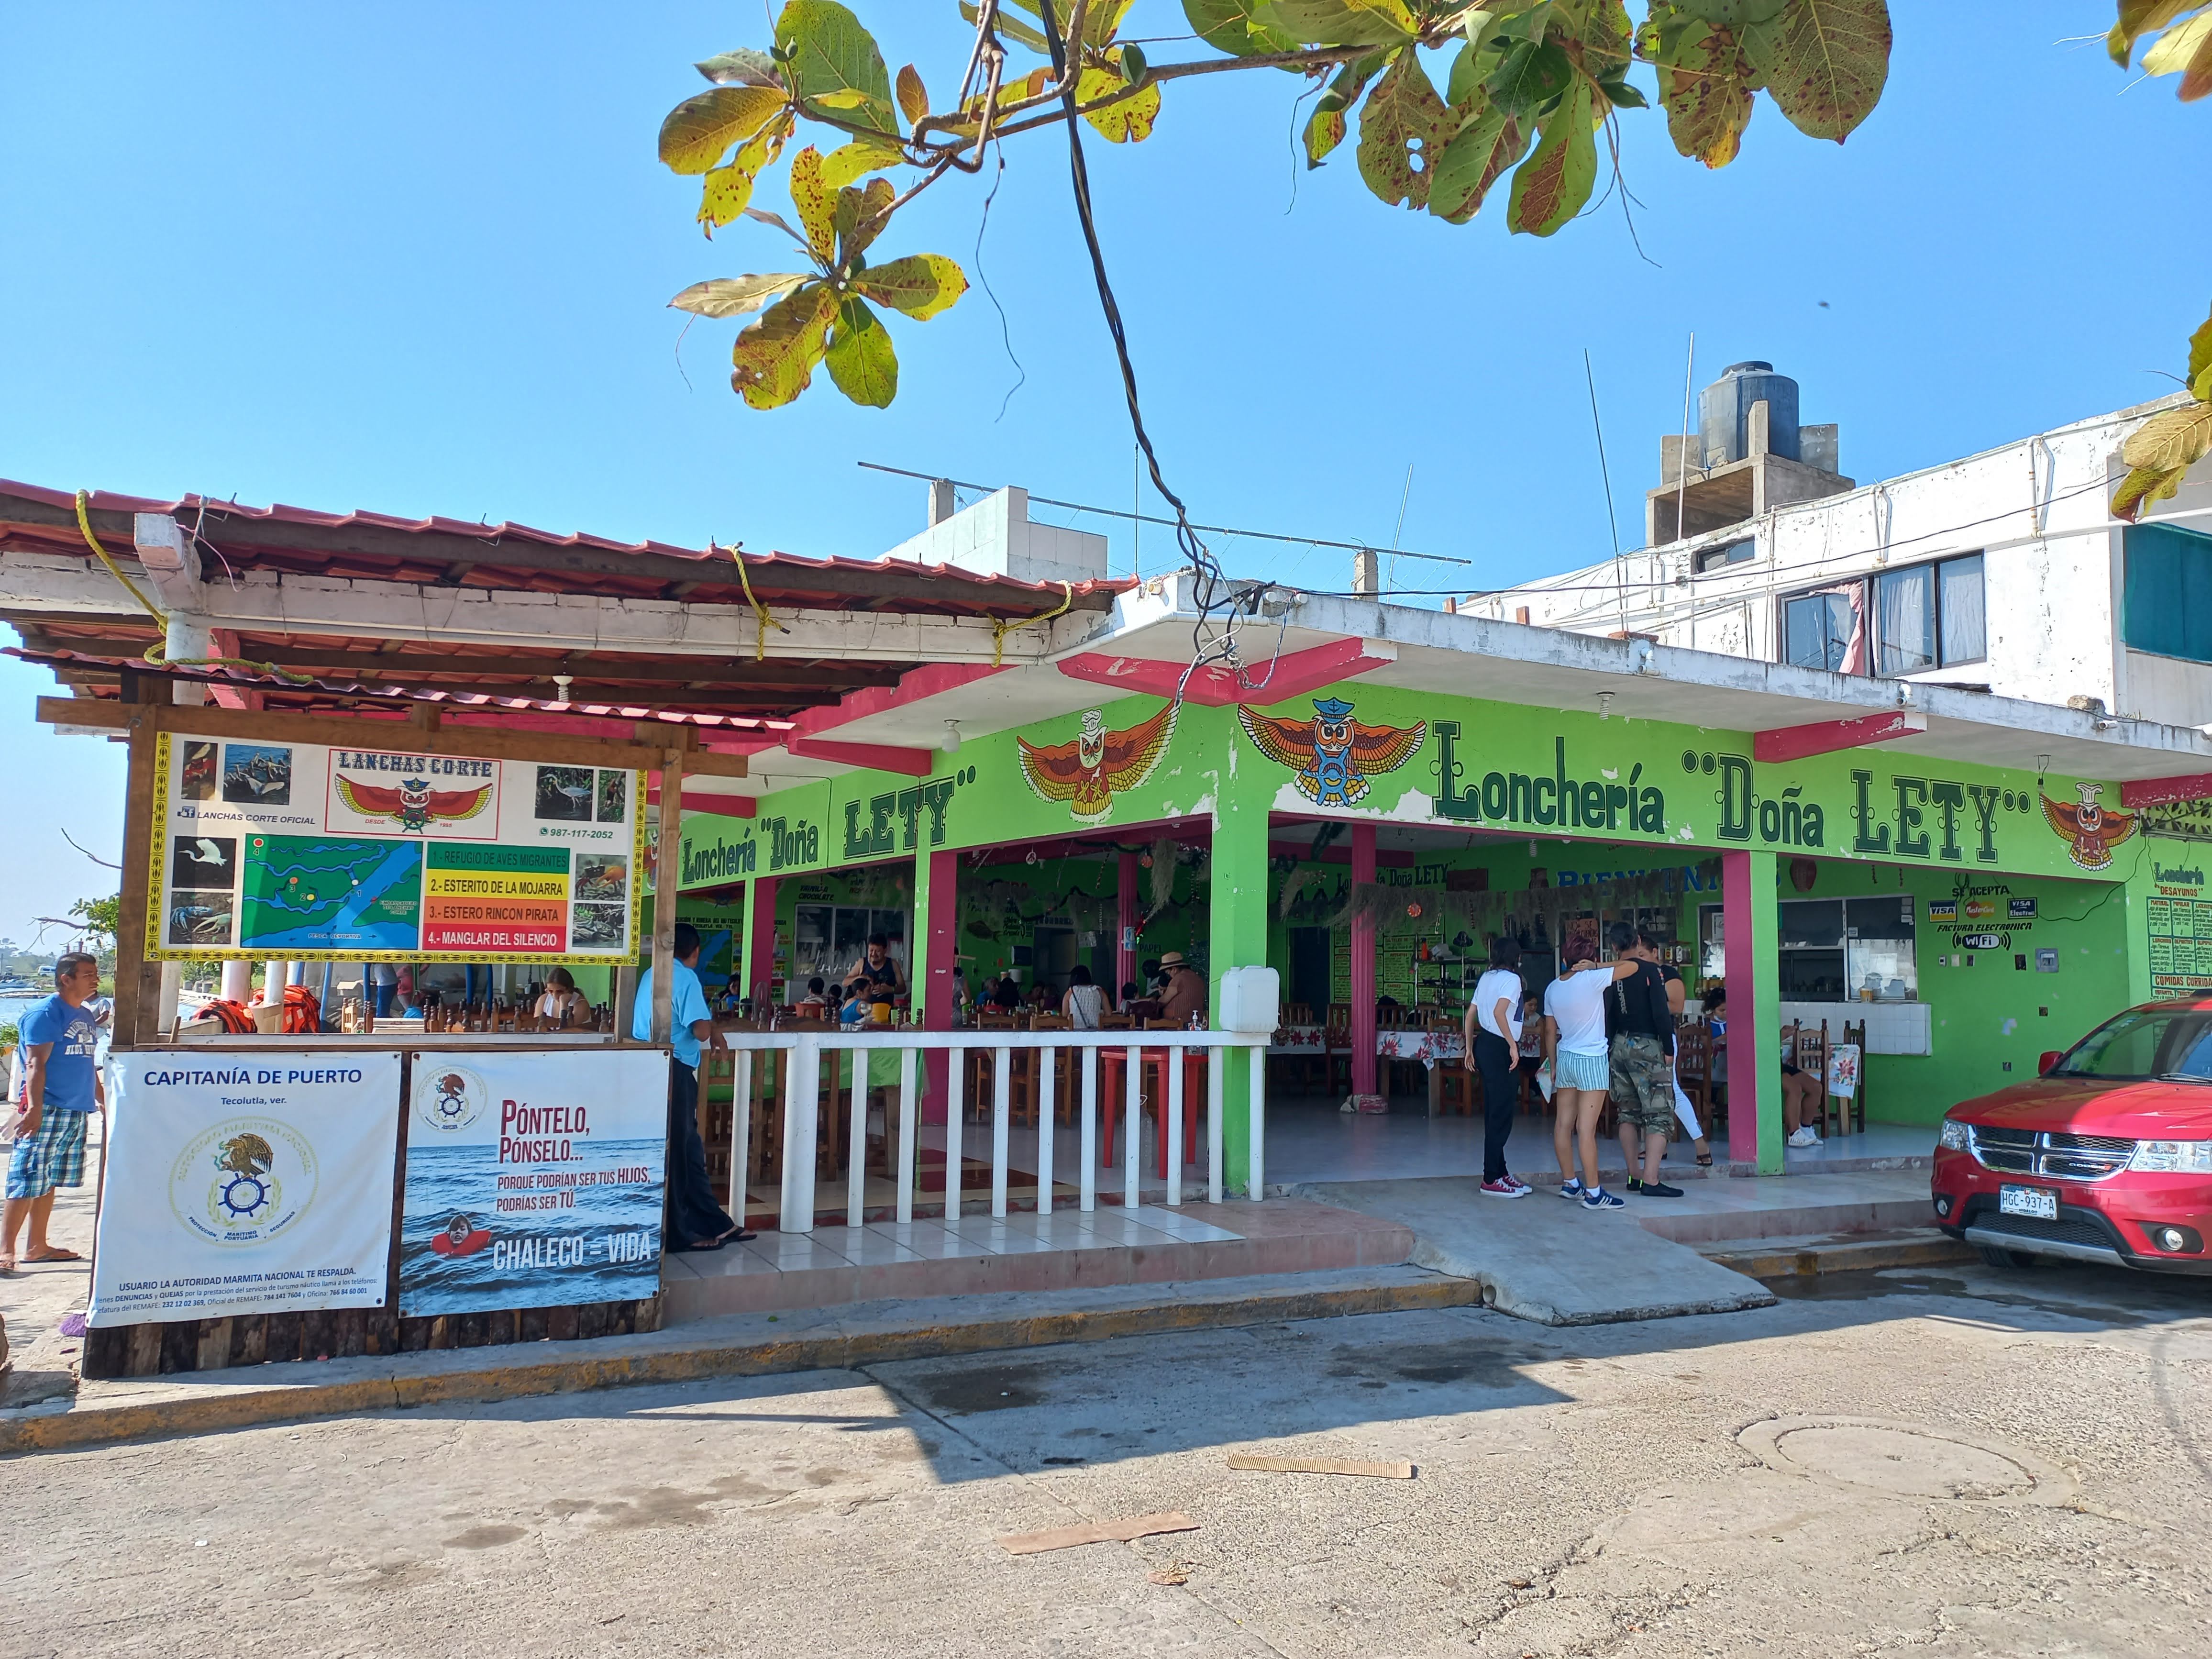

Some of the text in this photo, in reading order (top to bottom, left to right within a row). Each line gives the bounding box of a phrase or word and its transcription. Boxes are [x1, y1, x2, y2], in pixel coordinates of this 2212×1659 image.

[338, 752, 492, 777] LANCHAS CORTE
[1430, 719, 1665, 834] Lonchería
[197, 812, 315, 824] LANCHAS CORTE OFICIAL
[550, 828, 613, 839] 987-117-2052
[444, 851, 482, 863] REFUGIO
[484, 852, 495, 864] DE
[497, 852, 517, 865] AVES
[520, 854, 566, 867] MIGRANTES
[682, 827, 756, 885] Lonchería
[431, 879, 563, 895] 2.- ESTERITO DE LA MOJARRA
[1969, 885, 2010, 896] ACEPTA
[429, 906, 558, 921] 3.- ESTERO RINCON PIRATA
[428, 931, 557, 947] 4.- MANGLAR DEL SILENCIO
[1140, 944, 1163, 953] PAPEL
[2155, 975, 2184, 986] COMIDAS
[144, 1067, 362, 1086] CAPITANÍA DE PUERTO
[221, 1097, 267, 1106] Tecolutla,
[500, 1099, 590, 1137] PÓNTELO,
[499, 1137, 583, 1164] PÓNSELO...
[497, 1167, 651, 1190] PORQUE PODRÍAN SER TUS HIJOS,
[497, 1190, 576, 1212] PODRÍAS SER TÚ.
[2002, 1192, 2055, 1211] HGC-937-A
[188, 1216, 217, 1238] PROTECCIÓN
[270, 1211, 295, 1233] SEGURIDAD
[493, 1236, 584, 1271] CHALECO
[608, 1232, 652, 1263] VIDA
[119, 1281, 158, 1291] USUARIO
[160, 1280, 170, 1288] LA
[172, 1277, 221, 1287] AUTORIDAD
[223, 1274, 263, 1284] MARMITA
[265, 1271, 305, 1282] NACIONAL
[317, 1268, 356, 1277] RESPALDA.
[115, 1294, 153, 1302] DENUNCIAS
[159, 1291, 183, 1299] QUEJAS
[203, 1287, 233, 1297] prestación
[96, 1305, 120, 1314] efatura
[207, 1297, 226, 1305] Oficial
[236, 1295, 262, 1303] REMAFE:
